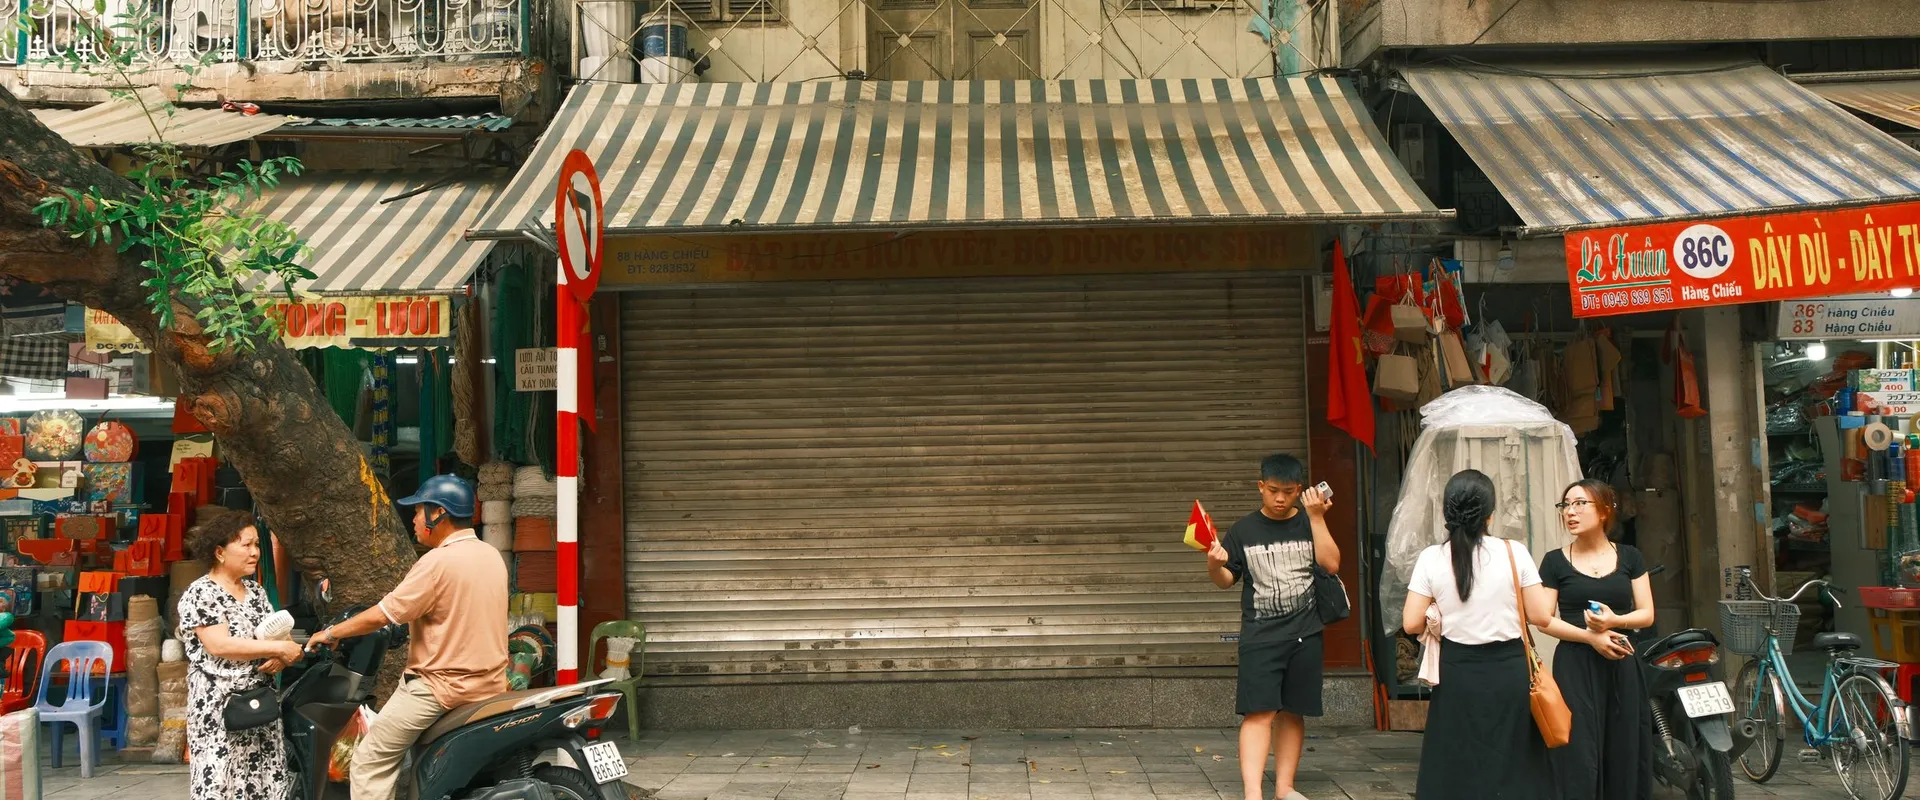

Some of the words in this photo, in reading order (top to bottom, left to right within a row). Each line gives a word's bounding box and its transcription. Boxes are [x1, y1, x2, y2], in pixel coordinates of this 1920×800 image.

[616, 251, 630, 262] 88
[1576, 236, 1606, 283] Lê
[1608, 233, 1671, 281] Xuân
[1682, 234, 1729, 270] 86C
[1748, 221, 1793, 290] DÂY
[1798, 217, 1831, 286] DÙ
[1849, 213, 1893, 282] DÂY
[1581, 294, 1601, 310] ĐT:
[1602, 290, 1629, 308] 0943
[1631, 289, 1651, 306] 889
[1653, 287, 1674, 304] 851
[1681, 285, 1710, 302] Hàng
[1711, 280, 1743, 299] Chiếu
[376, 296, 440, 336] LƯỚI
[1827, 306, 1858, 320] Hàng
[1792, 319, 1814, 334] 83
[1825, 322, 1855, 335] Hàng
[1858, 320, 1892, 333] Chiếu
[493, 712, 543, 733] VISION
[594, 759, 626, 781] 886.05
